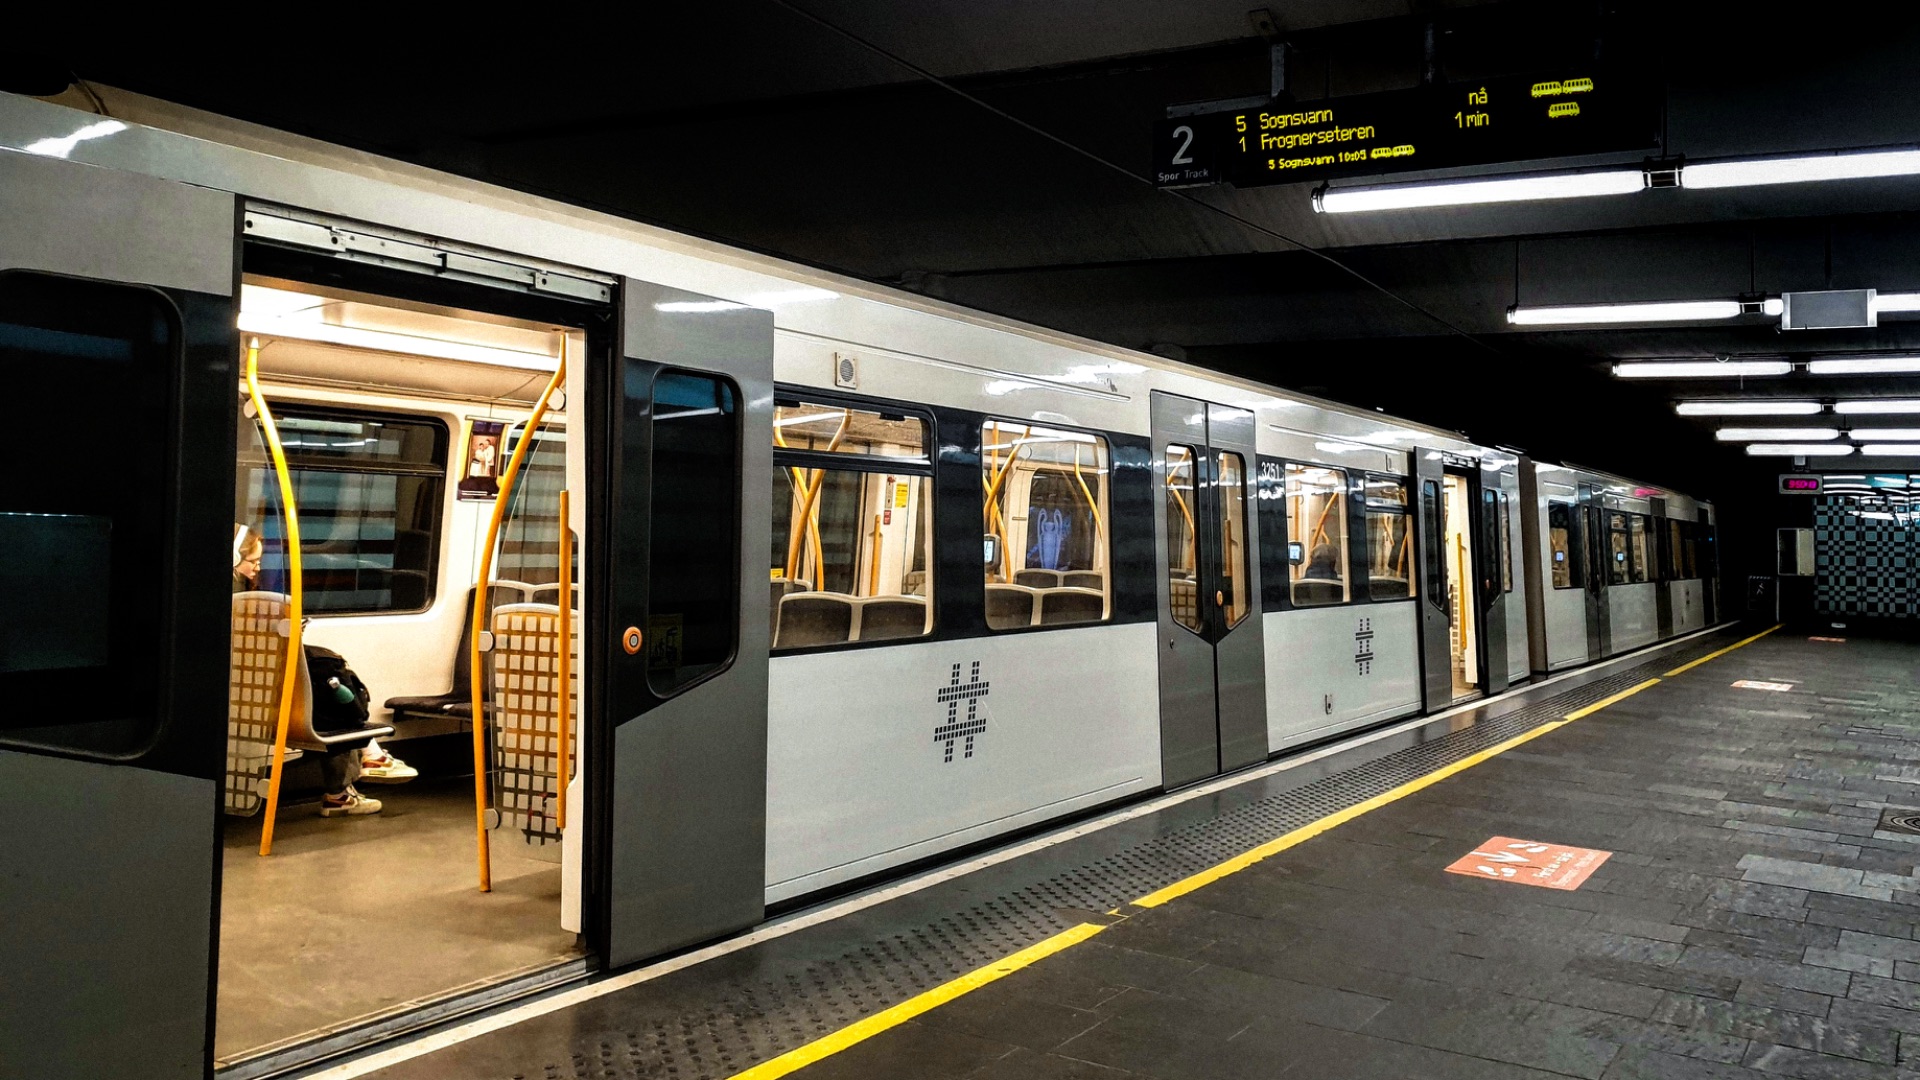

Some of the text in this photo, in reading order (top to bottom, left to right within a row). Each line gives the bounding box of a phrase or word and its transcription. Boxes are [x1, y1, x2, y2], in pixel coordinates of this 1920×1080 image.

[1236, 87, 1488, 132] 5 Sognsvann nå
[1172, 125, 1194, 165] 2
[1239, 110, 1490, 152] 1 Frognerseteren 1 min
[1158, 168, 1209, 183] Spor Track
[1278, 155, 1335, 169] Sognsvann
[1261, 461, 1279, 479] 3251
